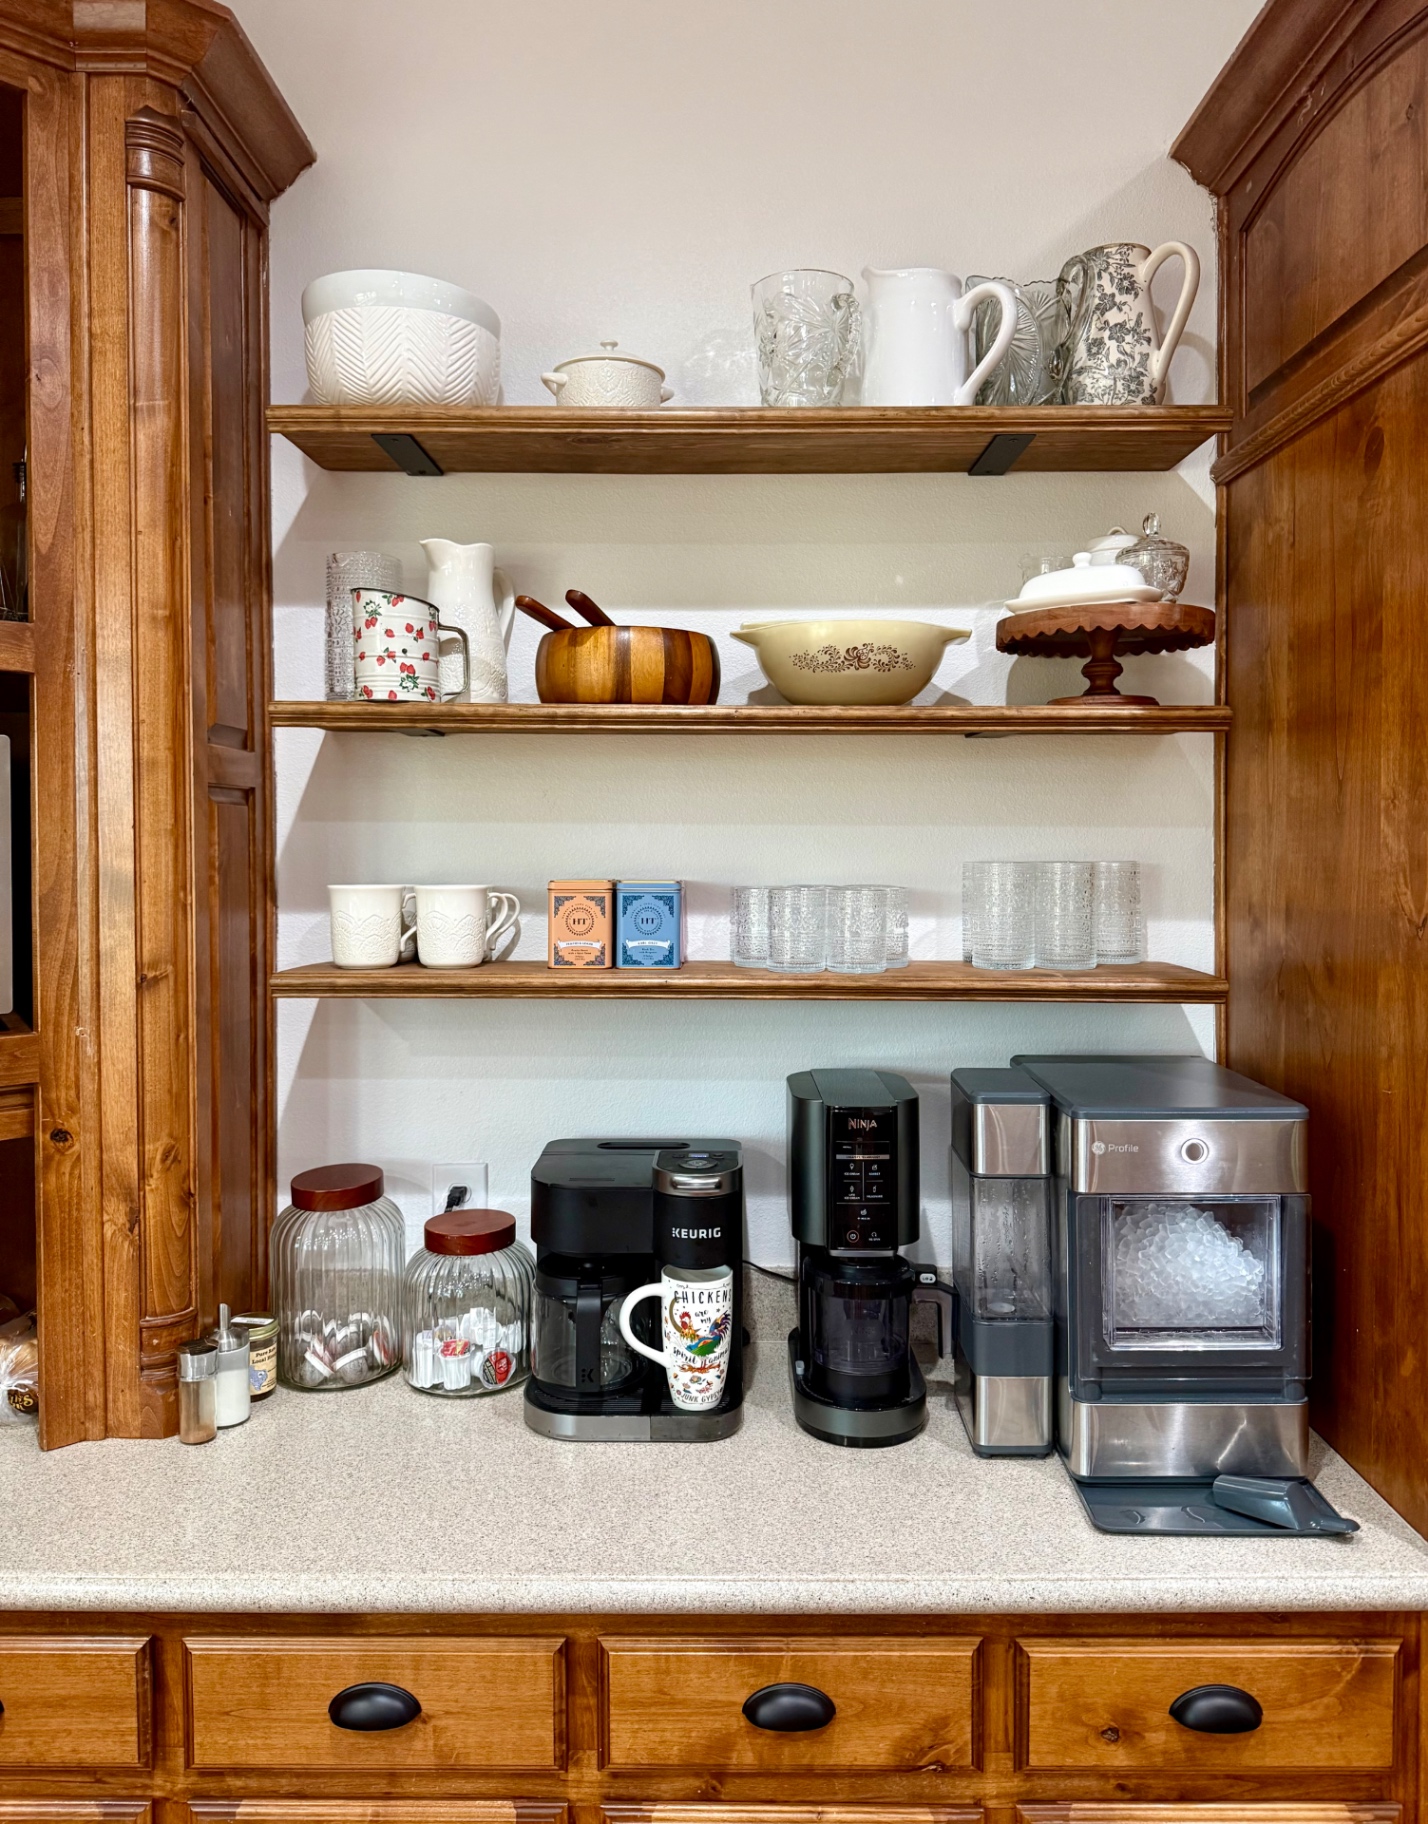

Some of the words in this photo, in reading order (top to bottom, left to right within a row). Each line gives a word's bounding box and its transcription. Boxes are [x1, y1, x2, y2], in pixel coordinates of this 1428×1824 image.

[848, 1117, 878, 1132] NINJA
[1108, 1143, 1139, 1153] Profile
[672, 1226, 721, 1239] KEURIG
[674, 1288, 732, 1304] CHICKENS
[681, 1393, 699, 1403] JUNK
